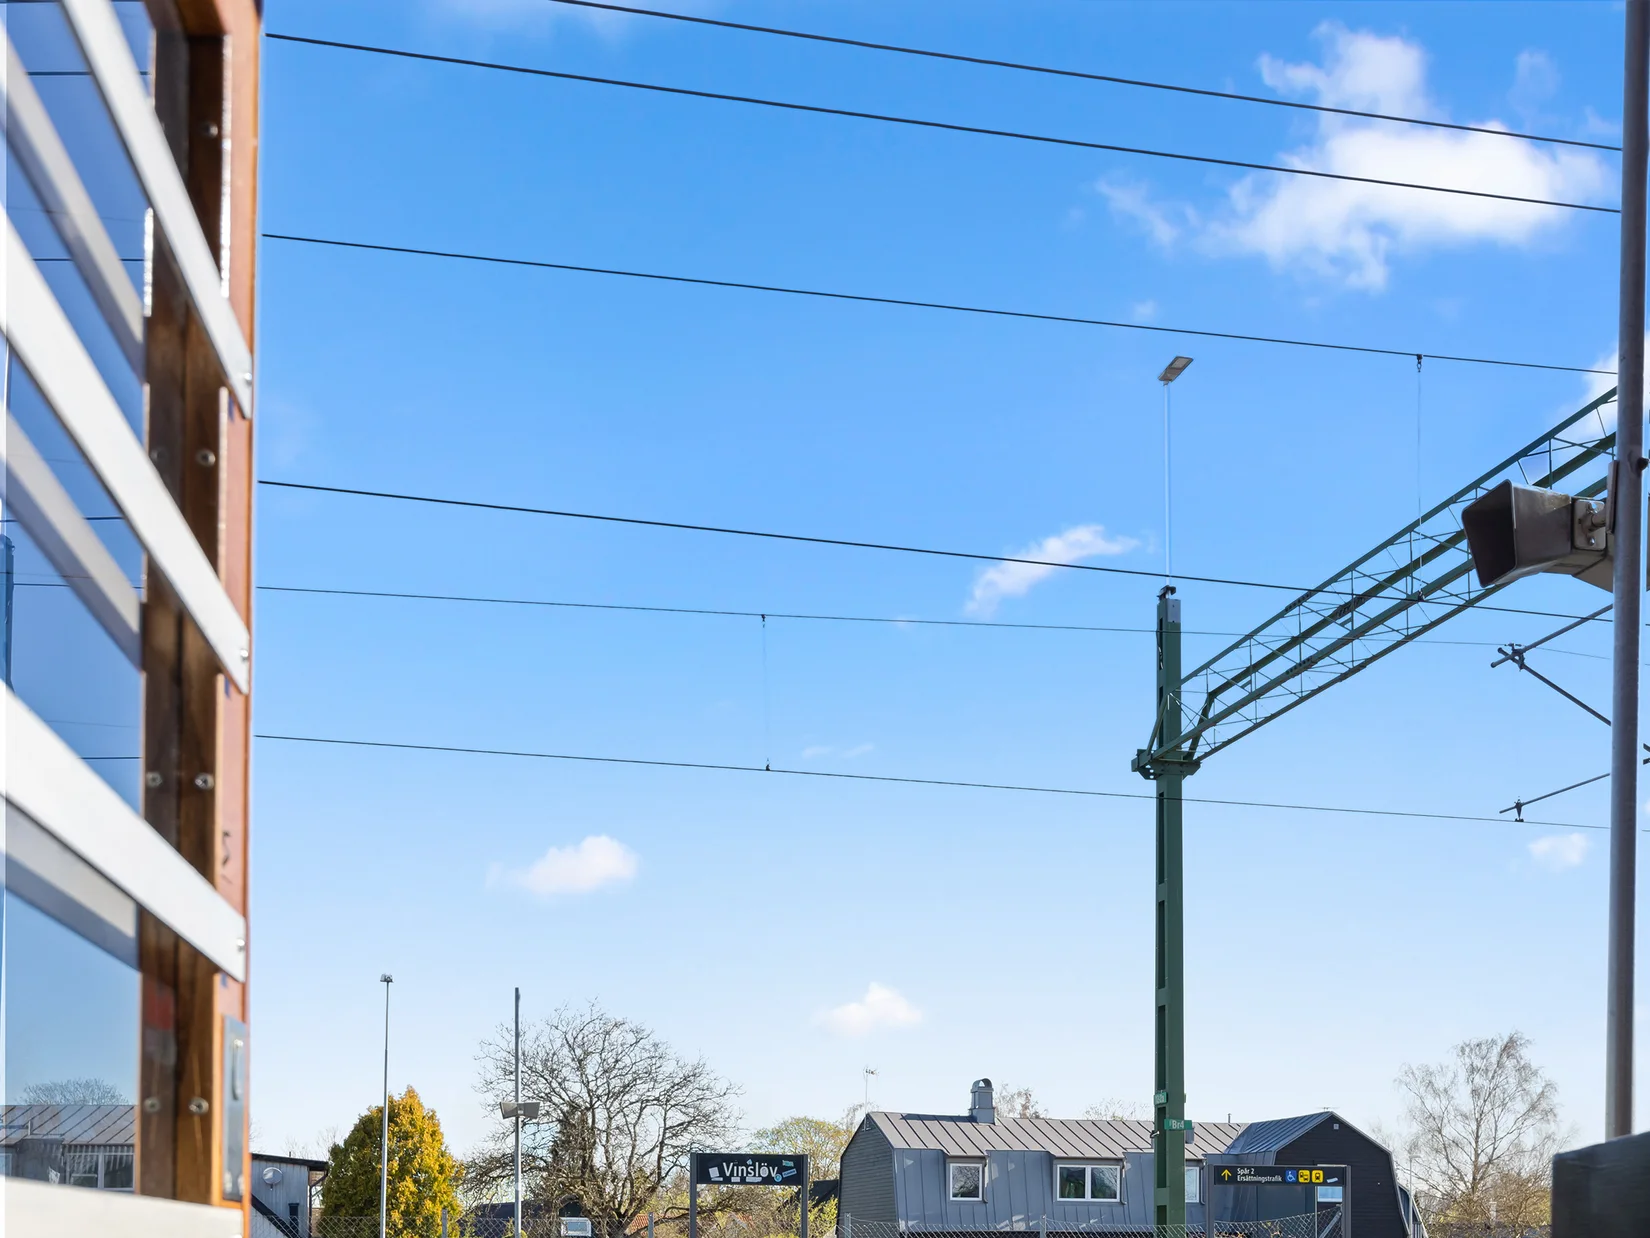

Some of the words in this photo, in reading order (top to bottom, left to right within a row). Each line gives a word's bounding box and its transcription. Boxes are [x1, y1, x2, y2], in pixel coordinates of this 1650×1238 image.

[722, 1162, 778, 1177] Vinslöv
[1237, 1167, 1250, 1176] Spår
[1237, 1175, 1282, 1184] Ersättningstrafik
